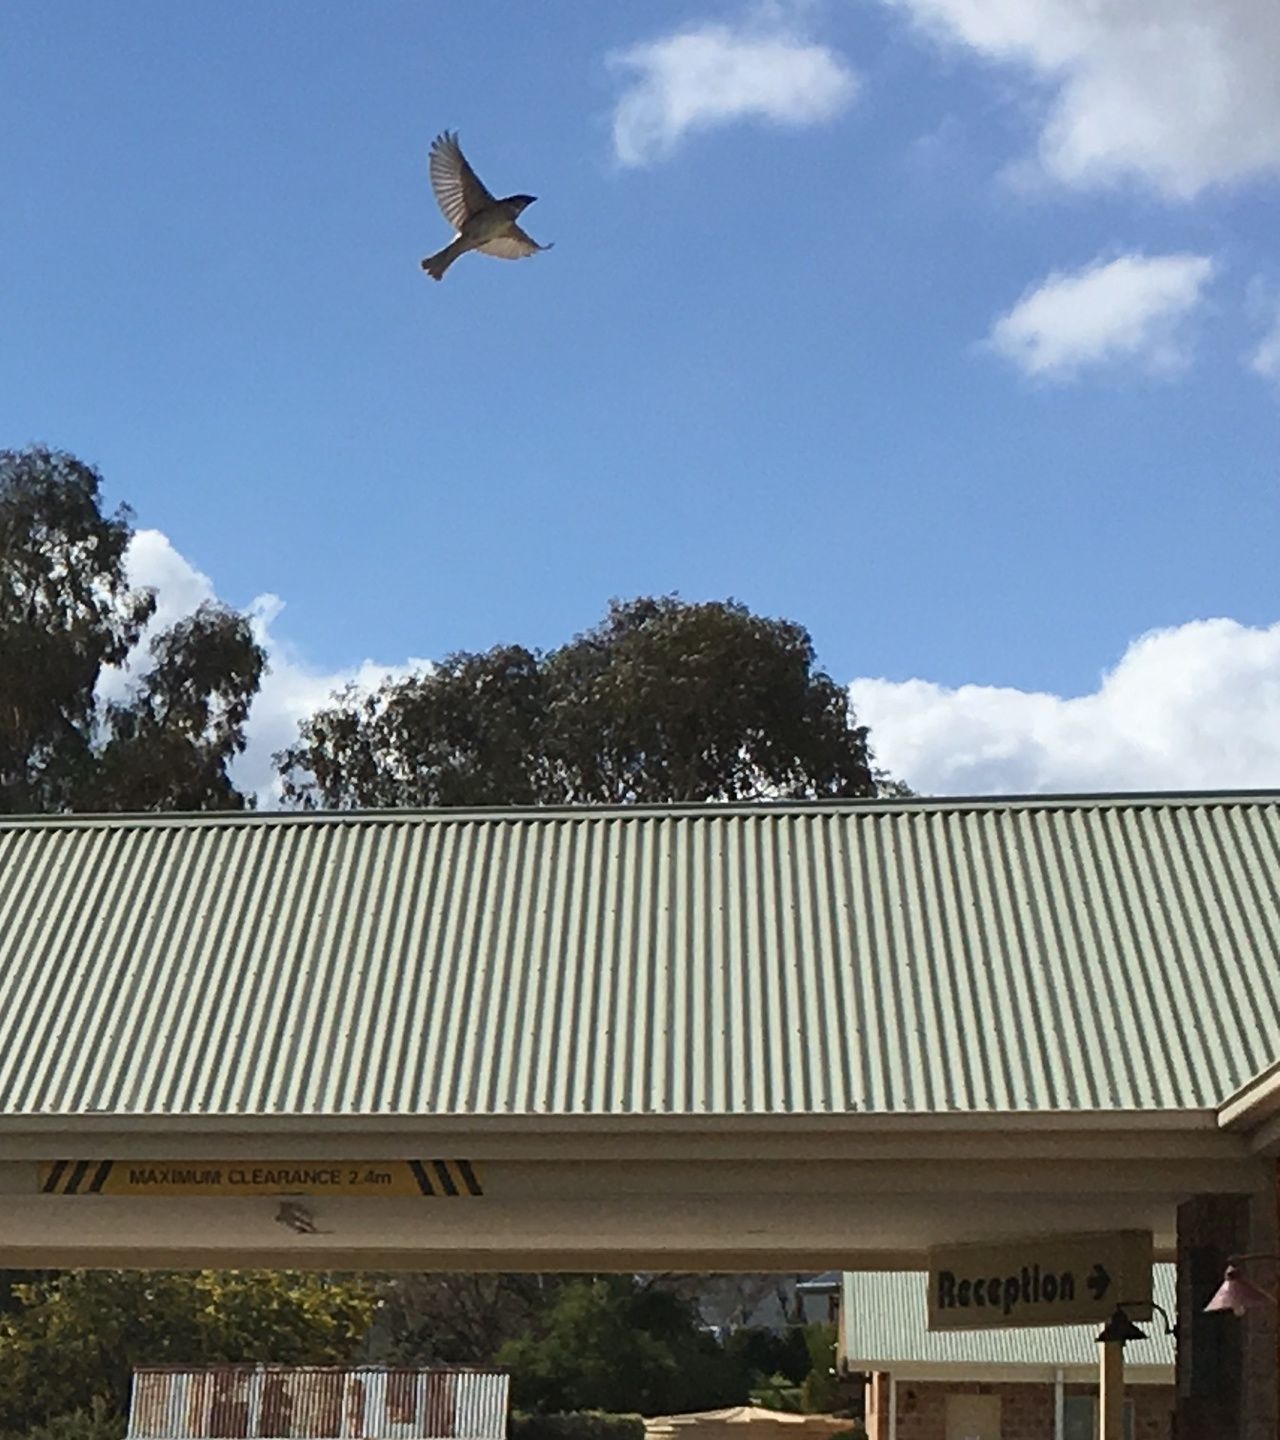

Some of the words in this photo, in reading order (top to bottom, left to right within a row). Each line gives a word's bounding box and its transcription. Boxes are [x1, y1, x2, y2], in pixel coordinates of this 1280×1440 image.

[128, 1168, 222, 1186] MAXIMUM
[228, 1168, 340, 1186] CLEARANCE
[937, 1263, 1075, 1315] Reception
